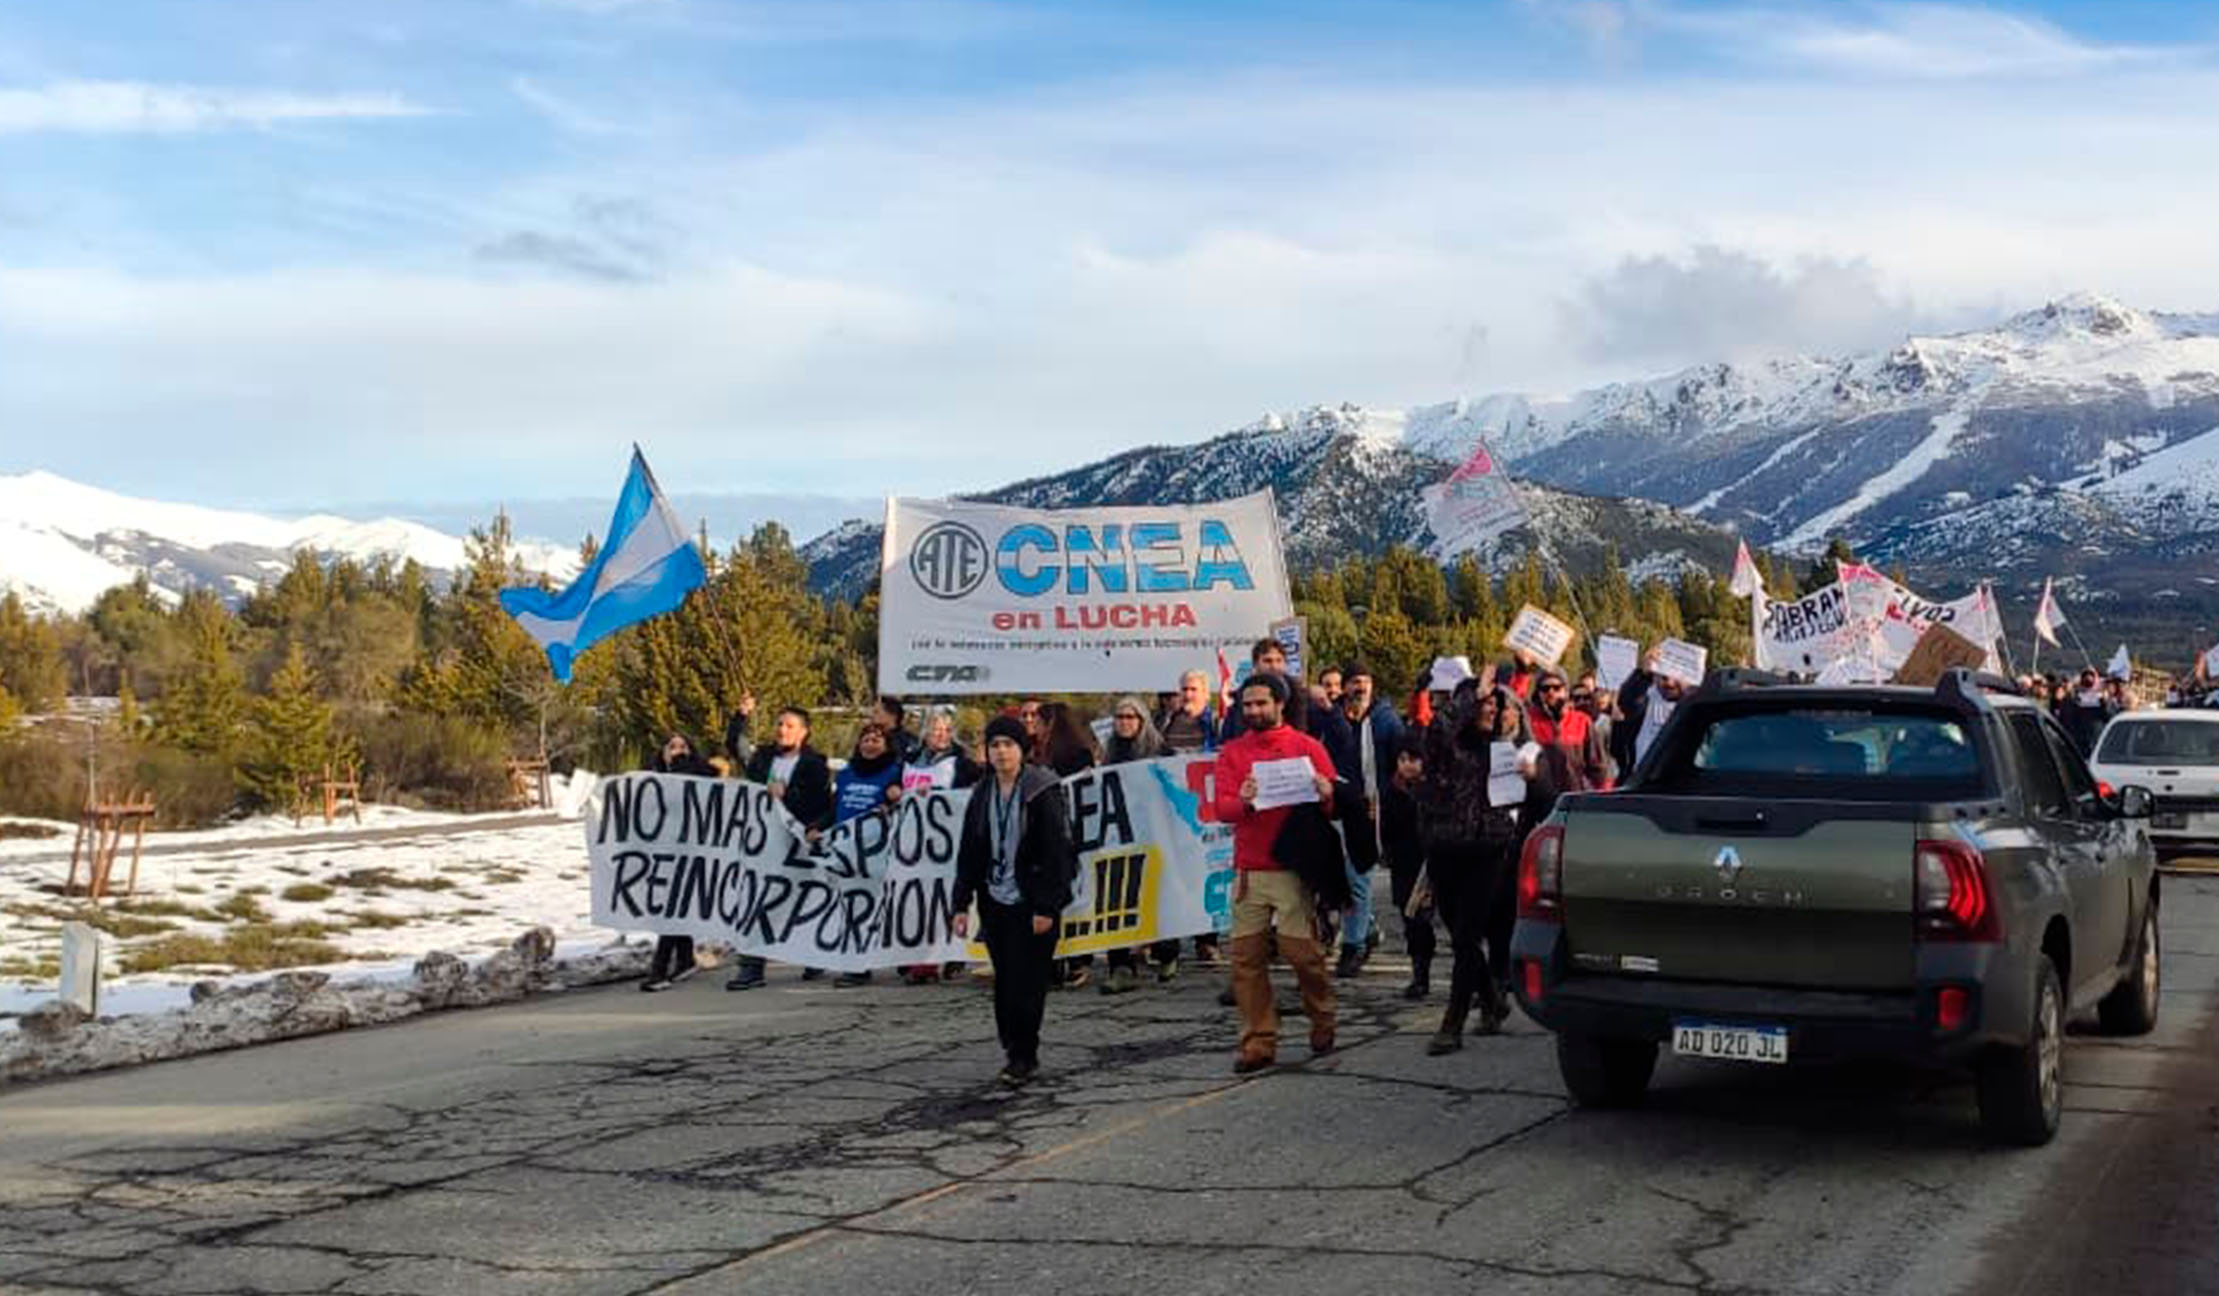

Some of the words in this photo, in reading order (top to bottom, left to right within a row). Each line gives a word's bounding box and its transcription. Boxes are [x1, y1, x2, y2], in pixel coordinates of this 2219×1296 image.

[917, 529, 980, 593] ATE
[995, 522, 1256, 598] CNEA
[992, 612, 1041, 631] en
[1054, 603, 1198, 630] LUCHA
[598, 776, 667, 844] NO
[678, 780, 773, 857] MAS
[1680, 1029, 1703, 1052] AD
[1711, 1031, 1748, 1055] 020
[1757, 1035, 1782, 1058] JL
